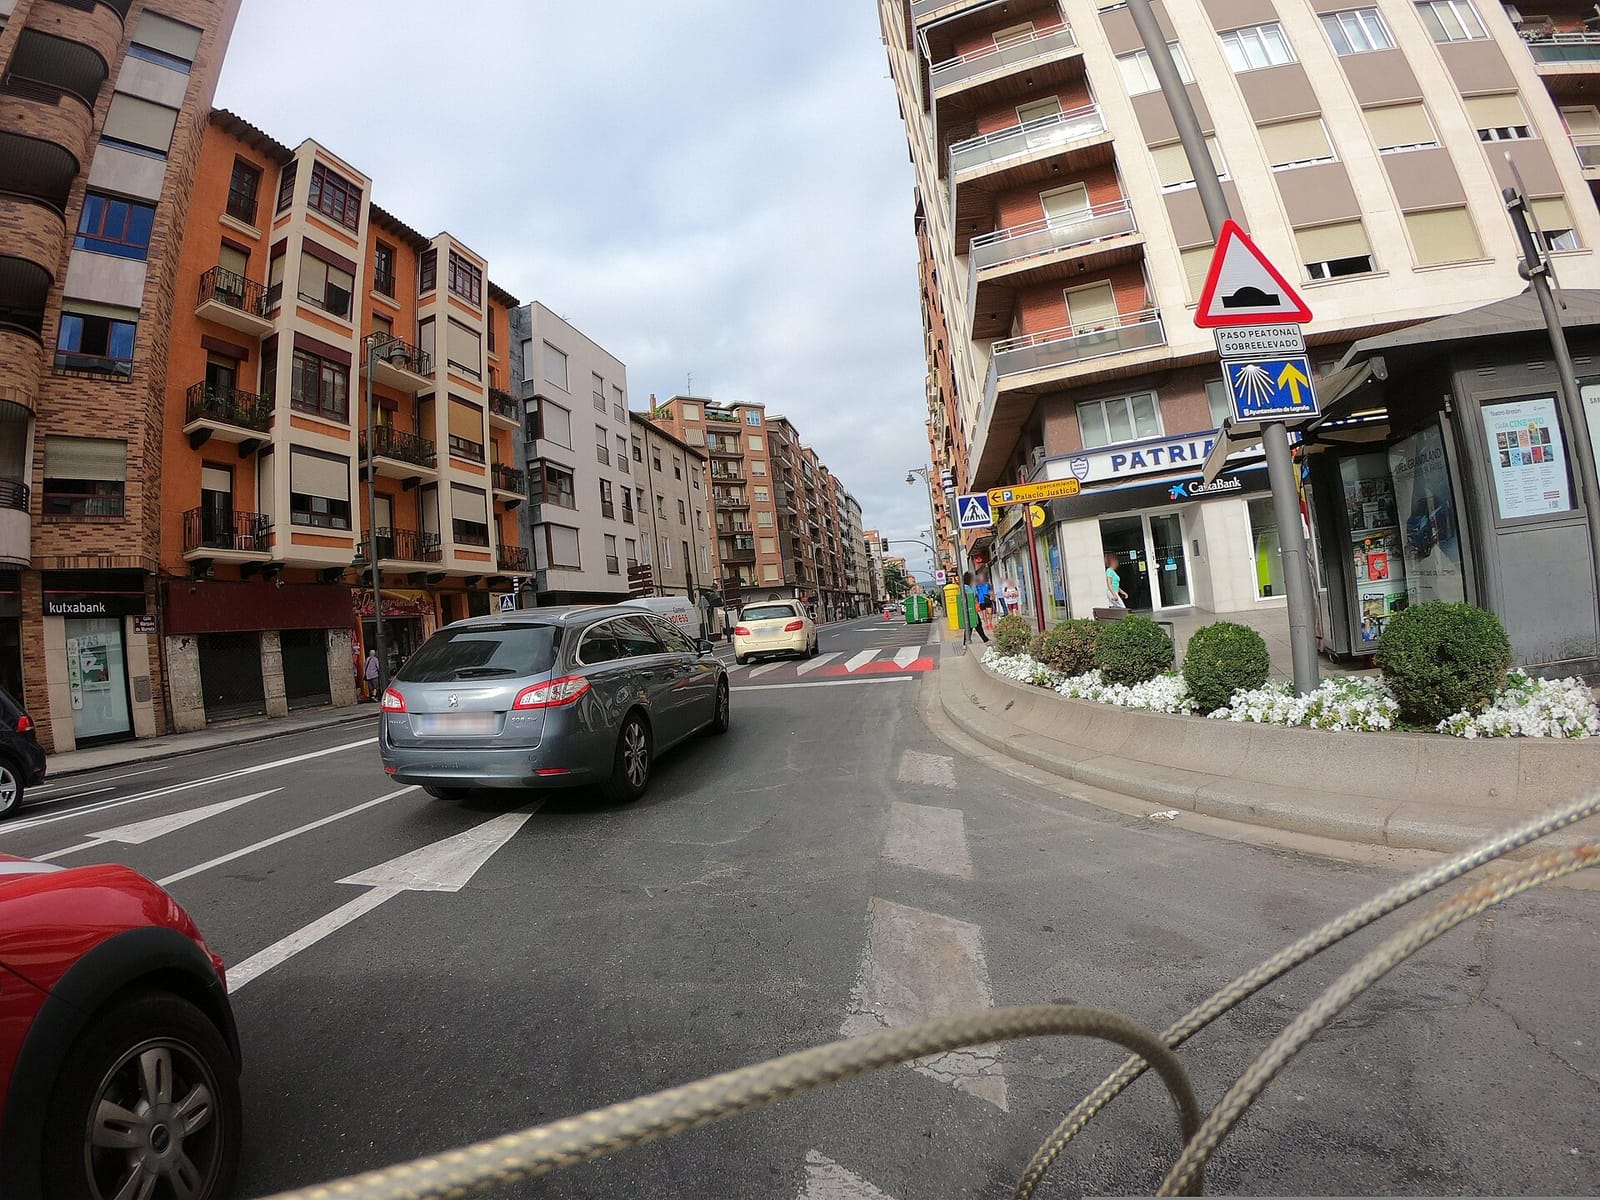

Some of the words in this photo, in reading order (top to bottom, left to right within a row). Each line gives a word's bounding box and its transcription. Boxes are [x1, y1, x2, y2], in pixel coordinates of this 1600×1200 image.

[1220, 331, 1247, 340] PASO
[1248, 328, 1298, 338] PEATONAL
[1224, 339, 1299, 351] SOBREELEVADO
[1111, 439, 1213, 472] PATRIA
[1036, 480, 1076, 490] aparcamiento
[1188, 477, 1242, 493] CaixaBank
[1003, 491, 1013, 501] P
[1015, 491, 1043, 500] Palacio
[1046, 487, 1077, 497] Justicia
[49, 601, 106, 613] kutxabank
